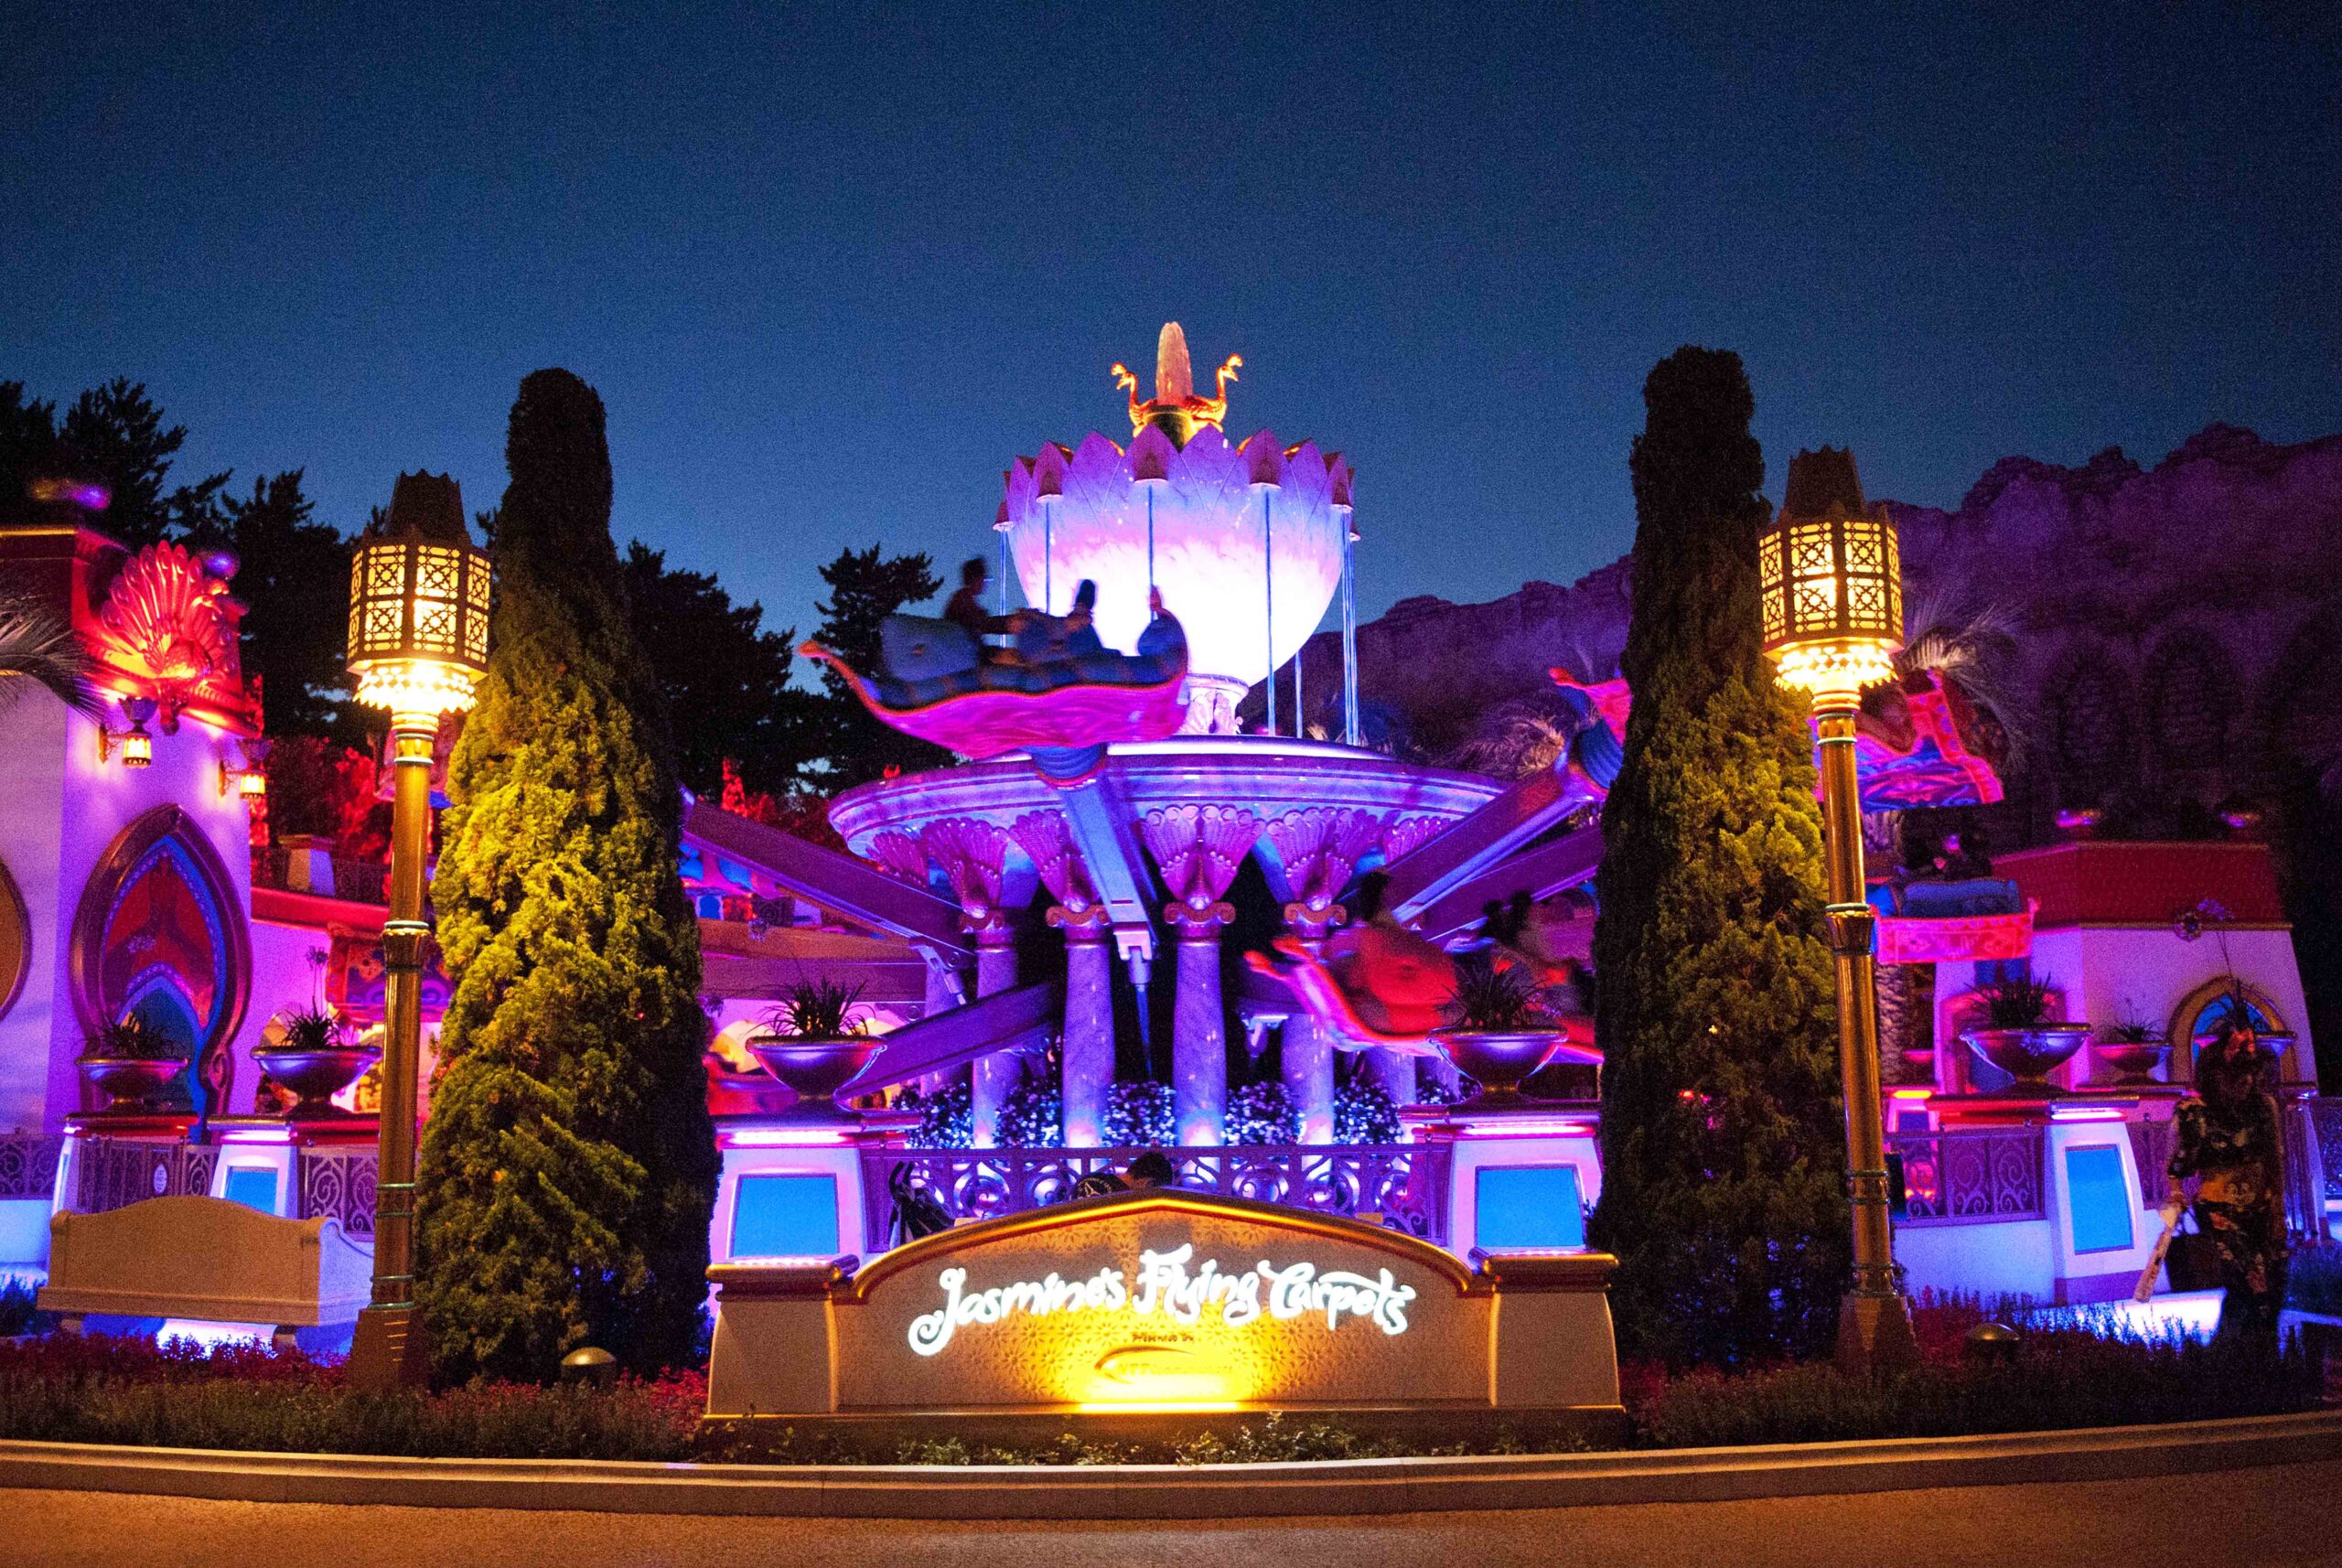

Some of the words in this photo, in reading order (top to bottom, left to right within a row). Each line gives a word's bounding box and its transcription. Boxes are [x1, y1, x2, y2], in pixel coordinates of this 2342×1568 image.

[908, 1268, 1127, 1356] Jasmine's
[1133, 1243, 1261, 1326] Flying
[1257, 1260, 1416, 1335] Carpets
